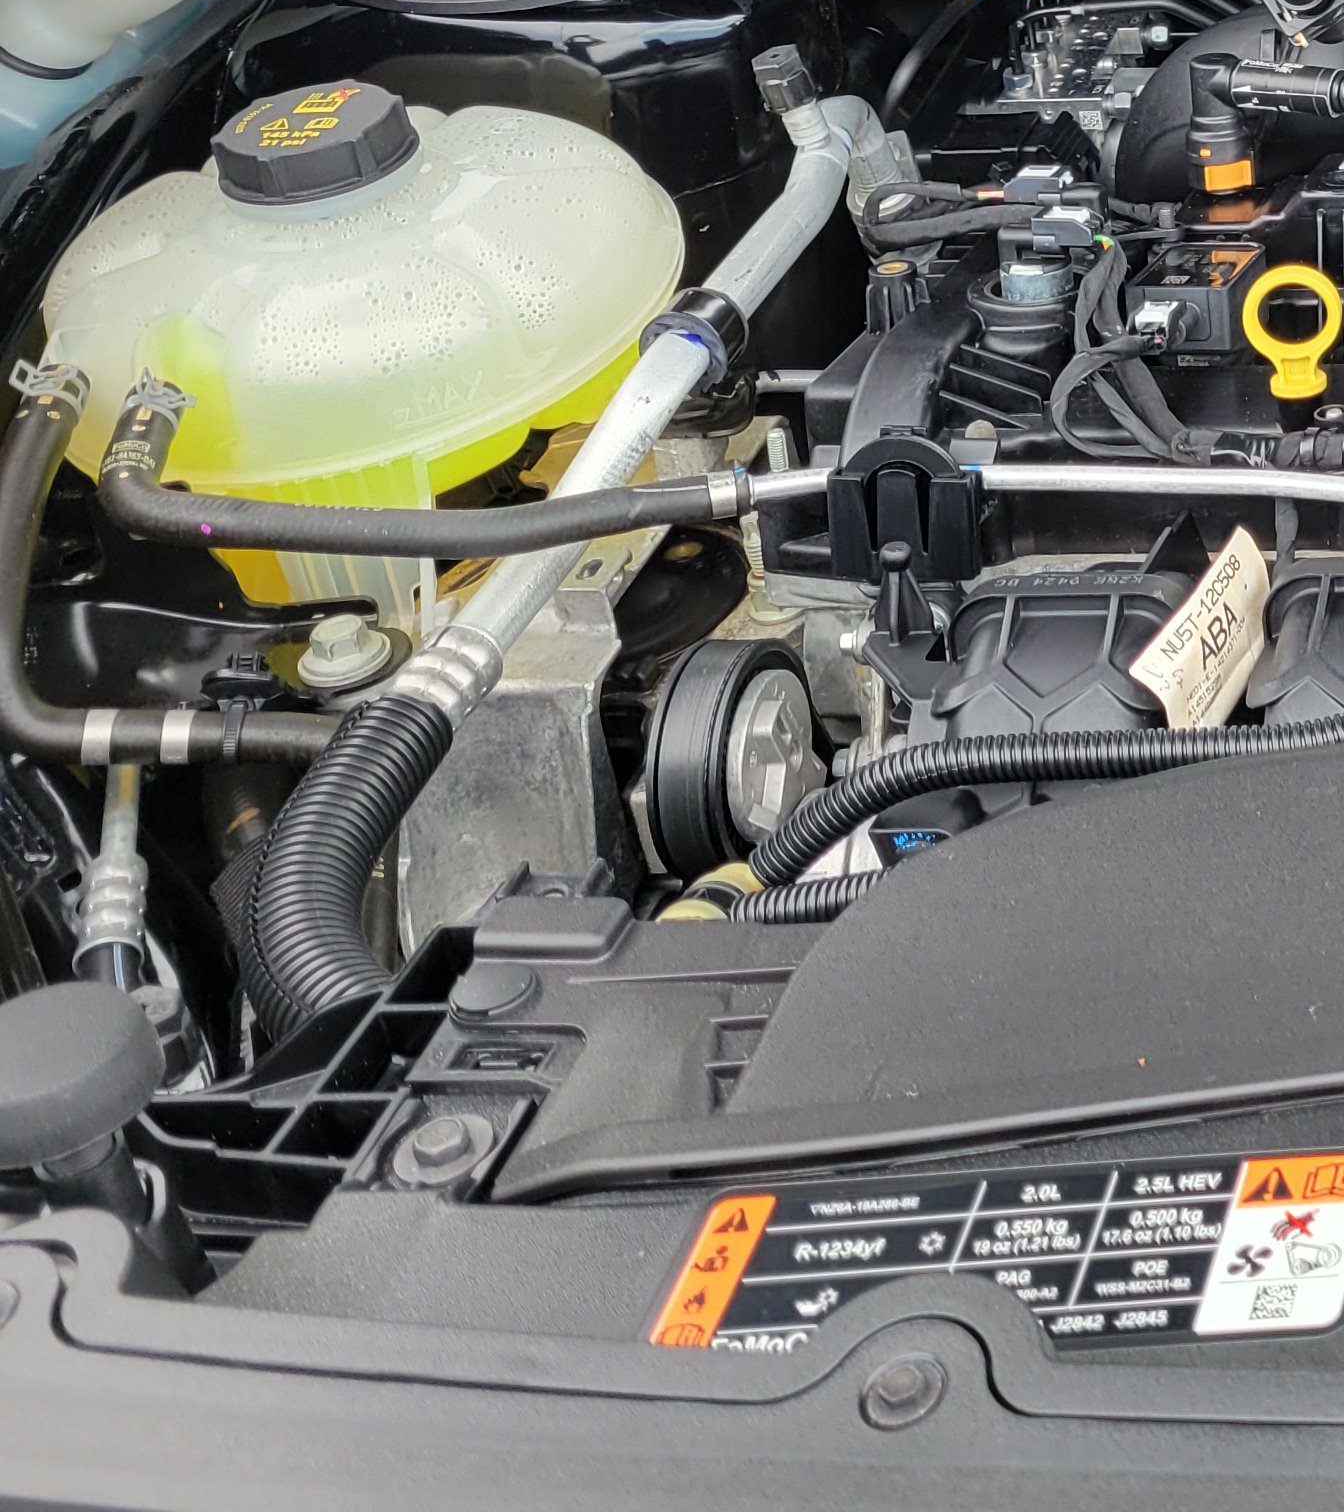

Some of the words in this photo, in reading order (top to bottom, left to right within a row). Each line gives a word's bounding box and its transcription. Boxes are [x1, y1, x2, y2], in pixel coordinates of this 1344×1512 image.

[258, 139, 279, 147] 21
[280, 137, 308, 147] psi
[262, 130, 290, 139] 145
[1159, 553, 1242, 662] NU5T-12C508
[1199, 601, 1238, 672] ABA
[1020, 1183, 1062, 1204] 2.0L
[1134, 1176, 1175, 1195] 2.5L
[1177, 1172, 1222, 1190] HEV
[994, 1219, 1043, 1238] 0.550
[1044, 1216, 1070, 1235] kg
[1129, 1208, 1178, 1229] 0.500
[1180, 1207, 1203, 1225] kg
[973, 1240, 991, 1256] 19
[992, 1241, 1011, 1255] oz
[1013, 1236, 1050, 1256] (1.21
[1052, 1233, 1082, 1251] lbs)
[1102, 1229, 1133, 1247] 17.6
[1134, 1230, 1153, 1245] oz
[1156, 1226, 1190, 1244] (1.10
[1192, 1222, 1222, 1239] lbs)
[793, 1238, 887, 1262] R-1234yf
[996, 1268, 1032, 1286] PAG
[1132, 1259, 1169, 1277] POE
[710, 1332, 808, 1352] FoMoC
[1051, 1314, 1105, 1333] J2842
[1113, 1309, 1169, 1329] J2845
